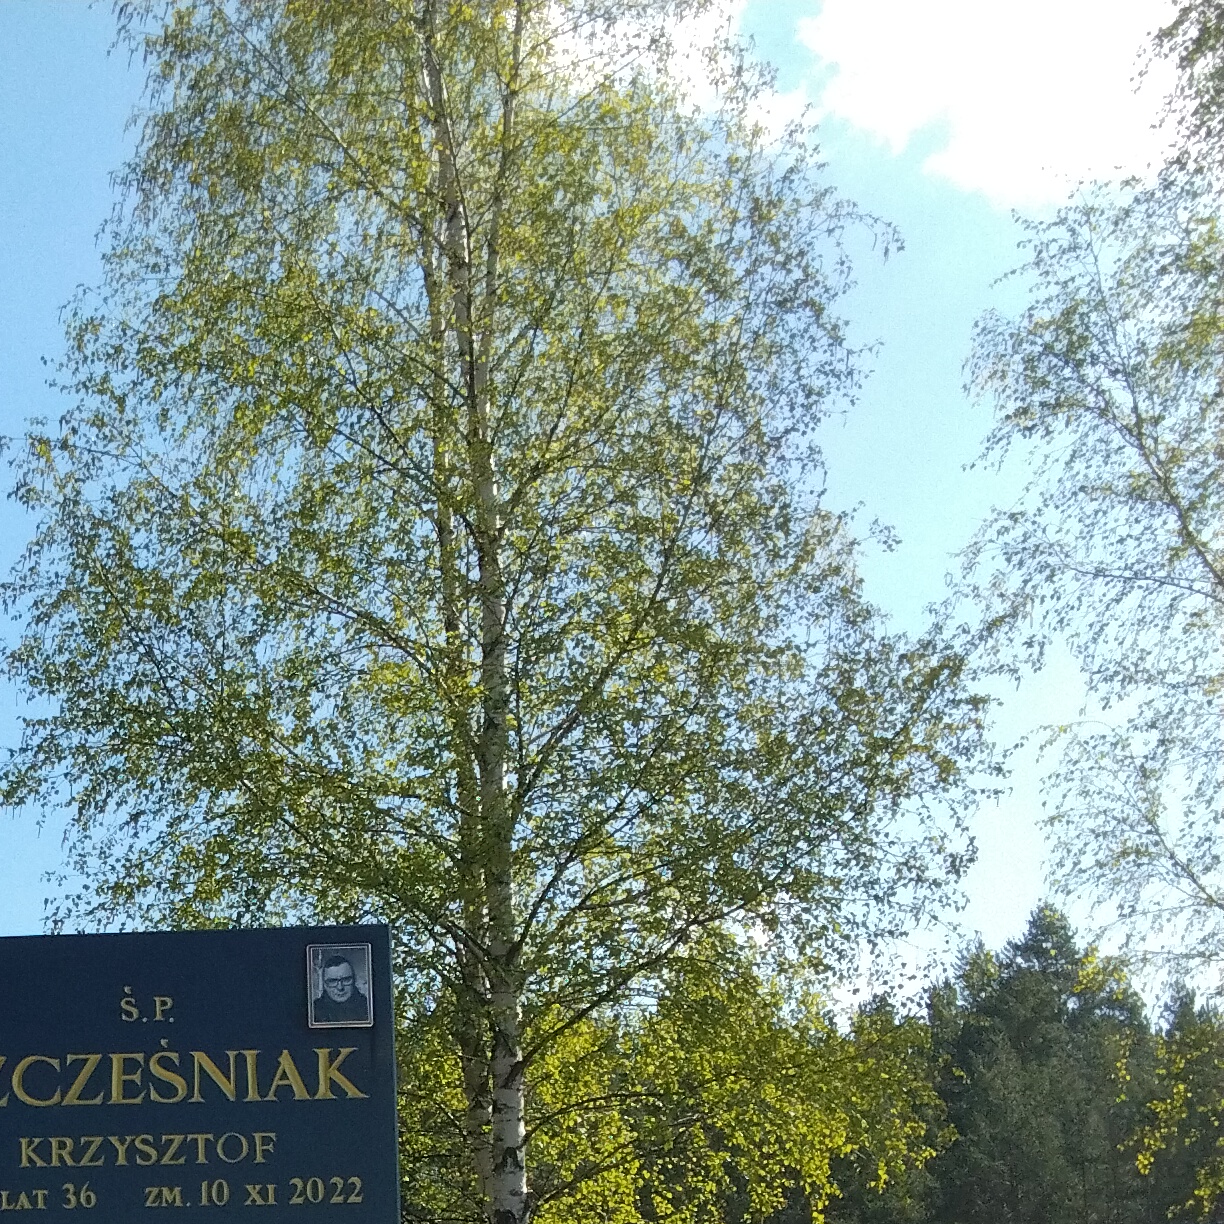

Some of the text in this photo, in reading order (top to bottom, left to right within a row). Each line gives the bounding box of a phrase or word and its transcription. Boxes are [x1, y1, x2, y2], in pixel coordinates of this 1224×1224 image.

[19, 1133, 276, 1169] KRZYSZTOF
[0, 1190, 48, 1209] LAT
[62, 1180, 97, 1209] 36
[145, 1186, 191, 1208] ZM.
[200, 1179, 229, 1207] 10
[244, 1184, 277, 1206] XI
[289, 1176, 364, 1206] 2022
